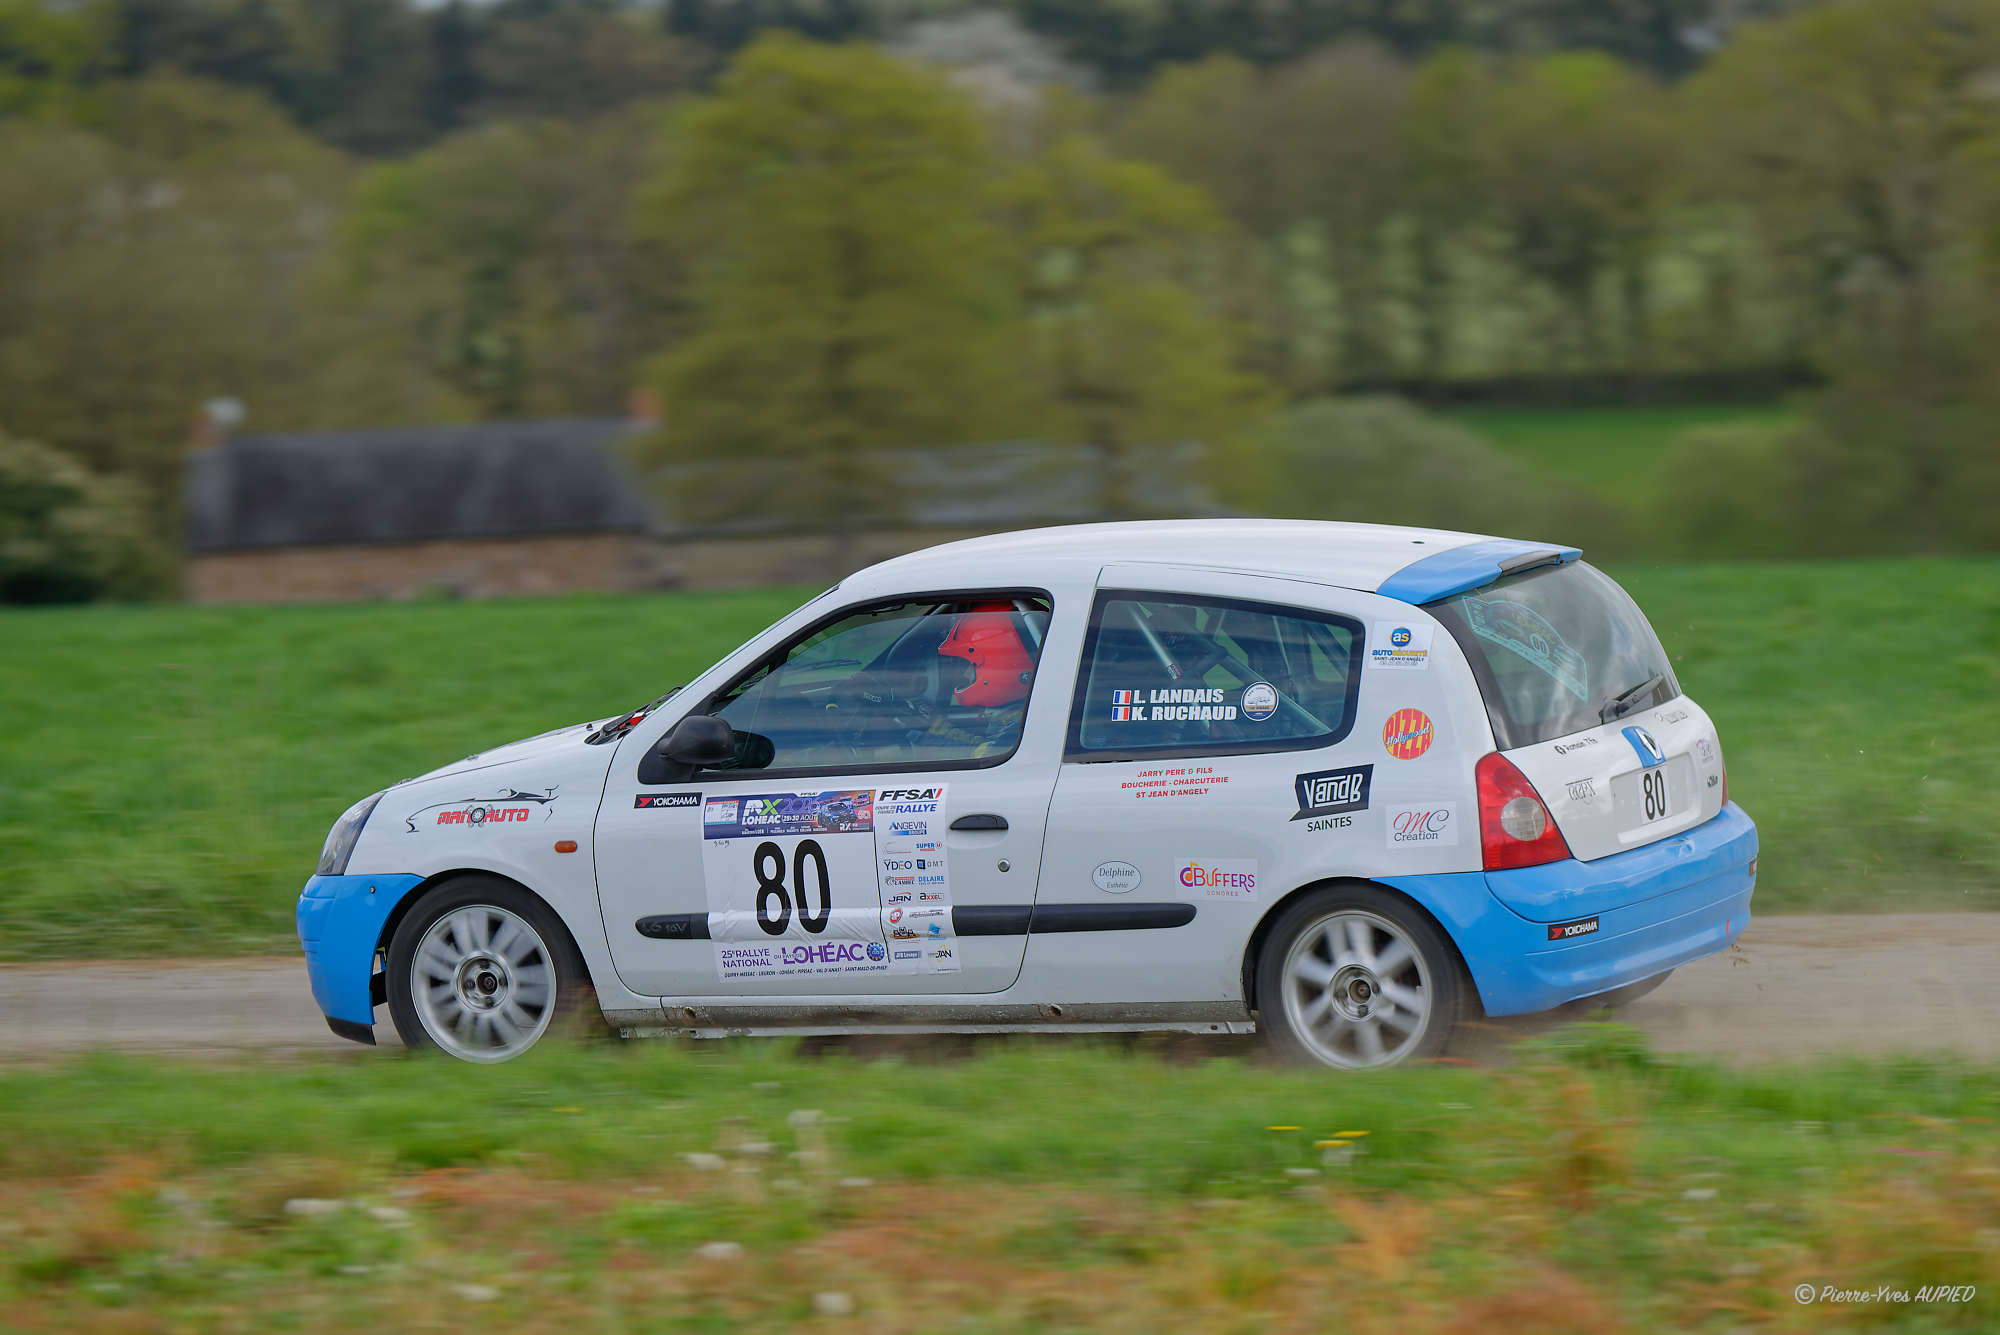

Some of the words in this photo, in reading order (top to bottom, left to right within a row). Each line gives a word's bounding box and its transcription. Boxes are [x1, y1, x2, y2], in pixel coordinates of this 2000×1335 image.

[1393, 632, 1409, 642] as
[1133, 690, 1146, 704] L.
[1150, 688, 1224, 703] LANDAIS
[1131, 706, 1148, 721] K.
[1151, 705, 1237, 721] RUCHAUD
[1137, 769, 1163, 778] JARRY
[1165, 768, 1186, 776] PERE
[1121, 780, 1167, 789] BOUCHERIE
[1173, 776, 1229, 786] CHARCUTERIE
[879, 788, 934, 802] FFSA
[1135, 791, 1146, 799] ST
[1148, 790, 1169, 798] JEAN
[1170, 788, 1209, 797] D'ANGELY
[1643, 770, 1665, 820] 80
[653, 796, 698, 806] YOKOHAMA
[896, 804, 937, 813] RALLYE
[741, 815, 782, 825] LOHEAC
[1307, 816, 1352, 832] SAINTES
[889, 821, 927, 831] ANGEVIN
[1394, 831, 1439, 842] Création
[1099, 867, 1135, 878] Delphine
[753, 839, 832, 936] 80
[1564, 919, 1598, 937] YOKOHAMA
[735, 948, 770, 958] RALLYE
[782, 941, 865, 965] LOHÉAC
[722, 958, 773, 968] NATIONAL
